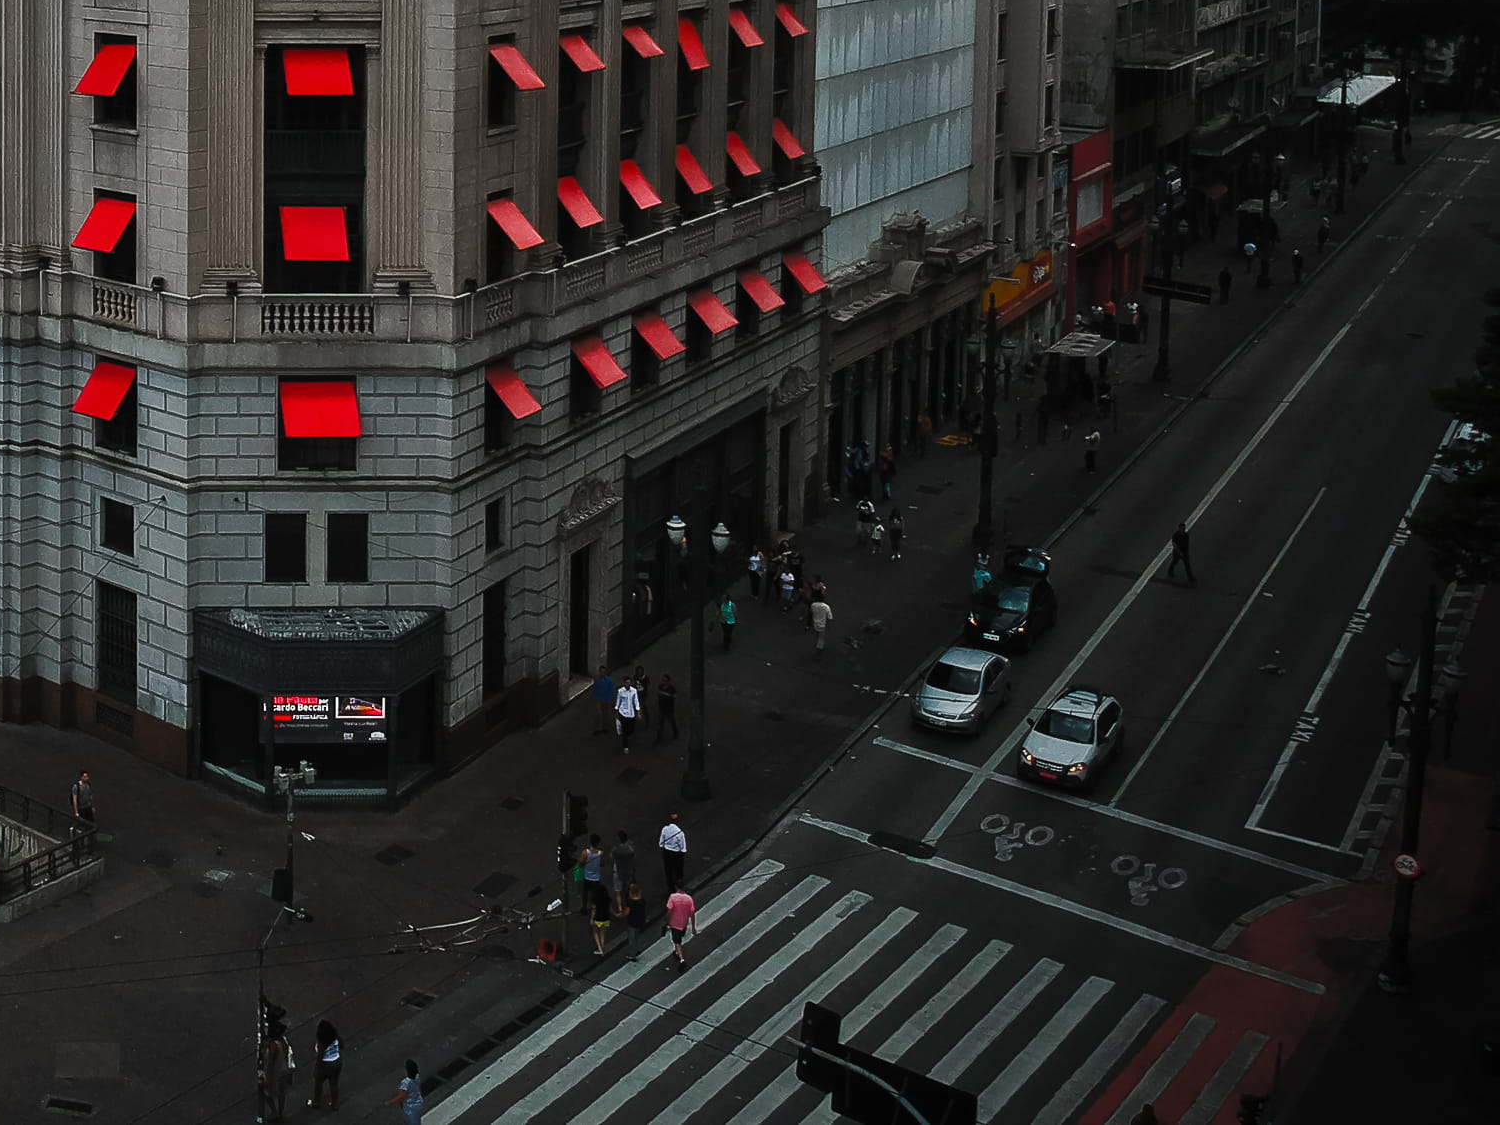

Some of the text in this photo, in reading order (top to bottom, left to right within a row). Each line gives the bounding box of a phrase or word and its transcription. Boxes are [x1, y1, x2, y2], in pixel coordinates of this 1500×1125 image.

[1345, 611, 1372, 634] TAXI
[297, 703, 329, 712] Beccari
[1290, 715, 1321, 743] TAXI
